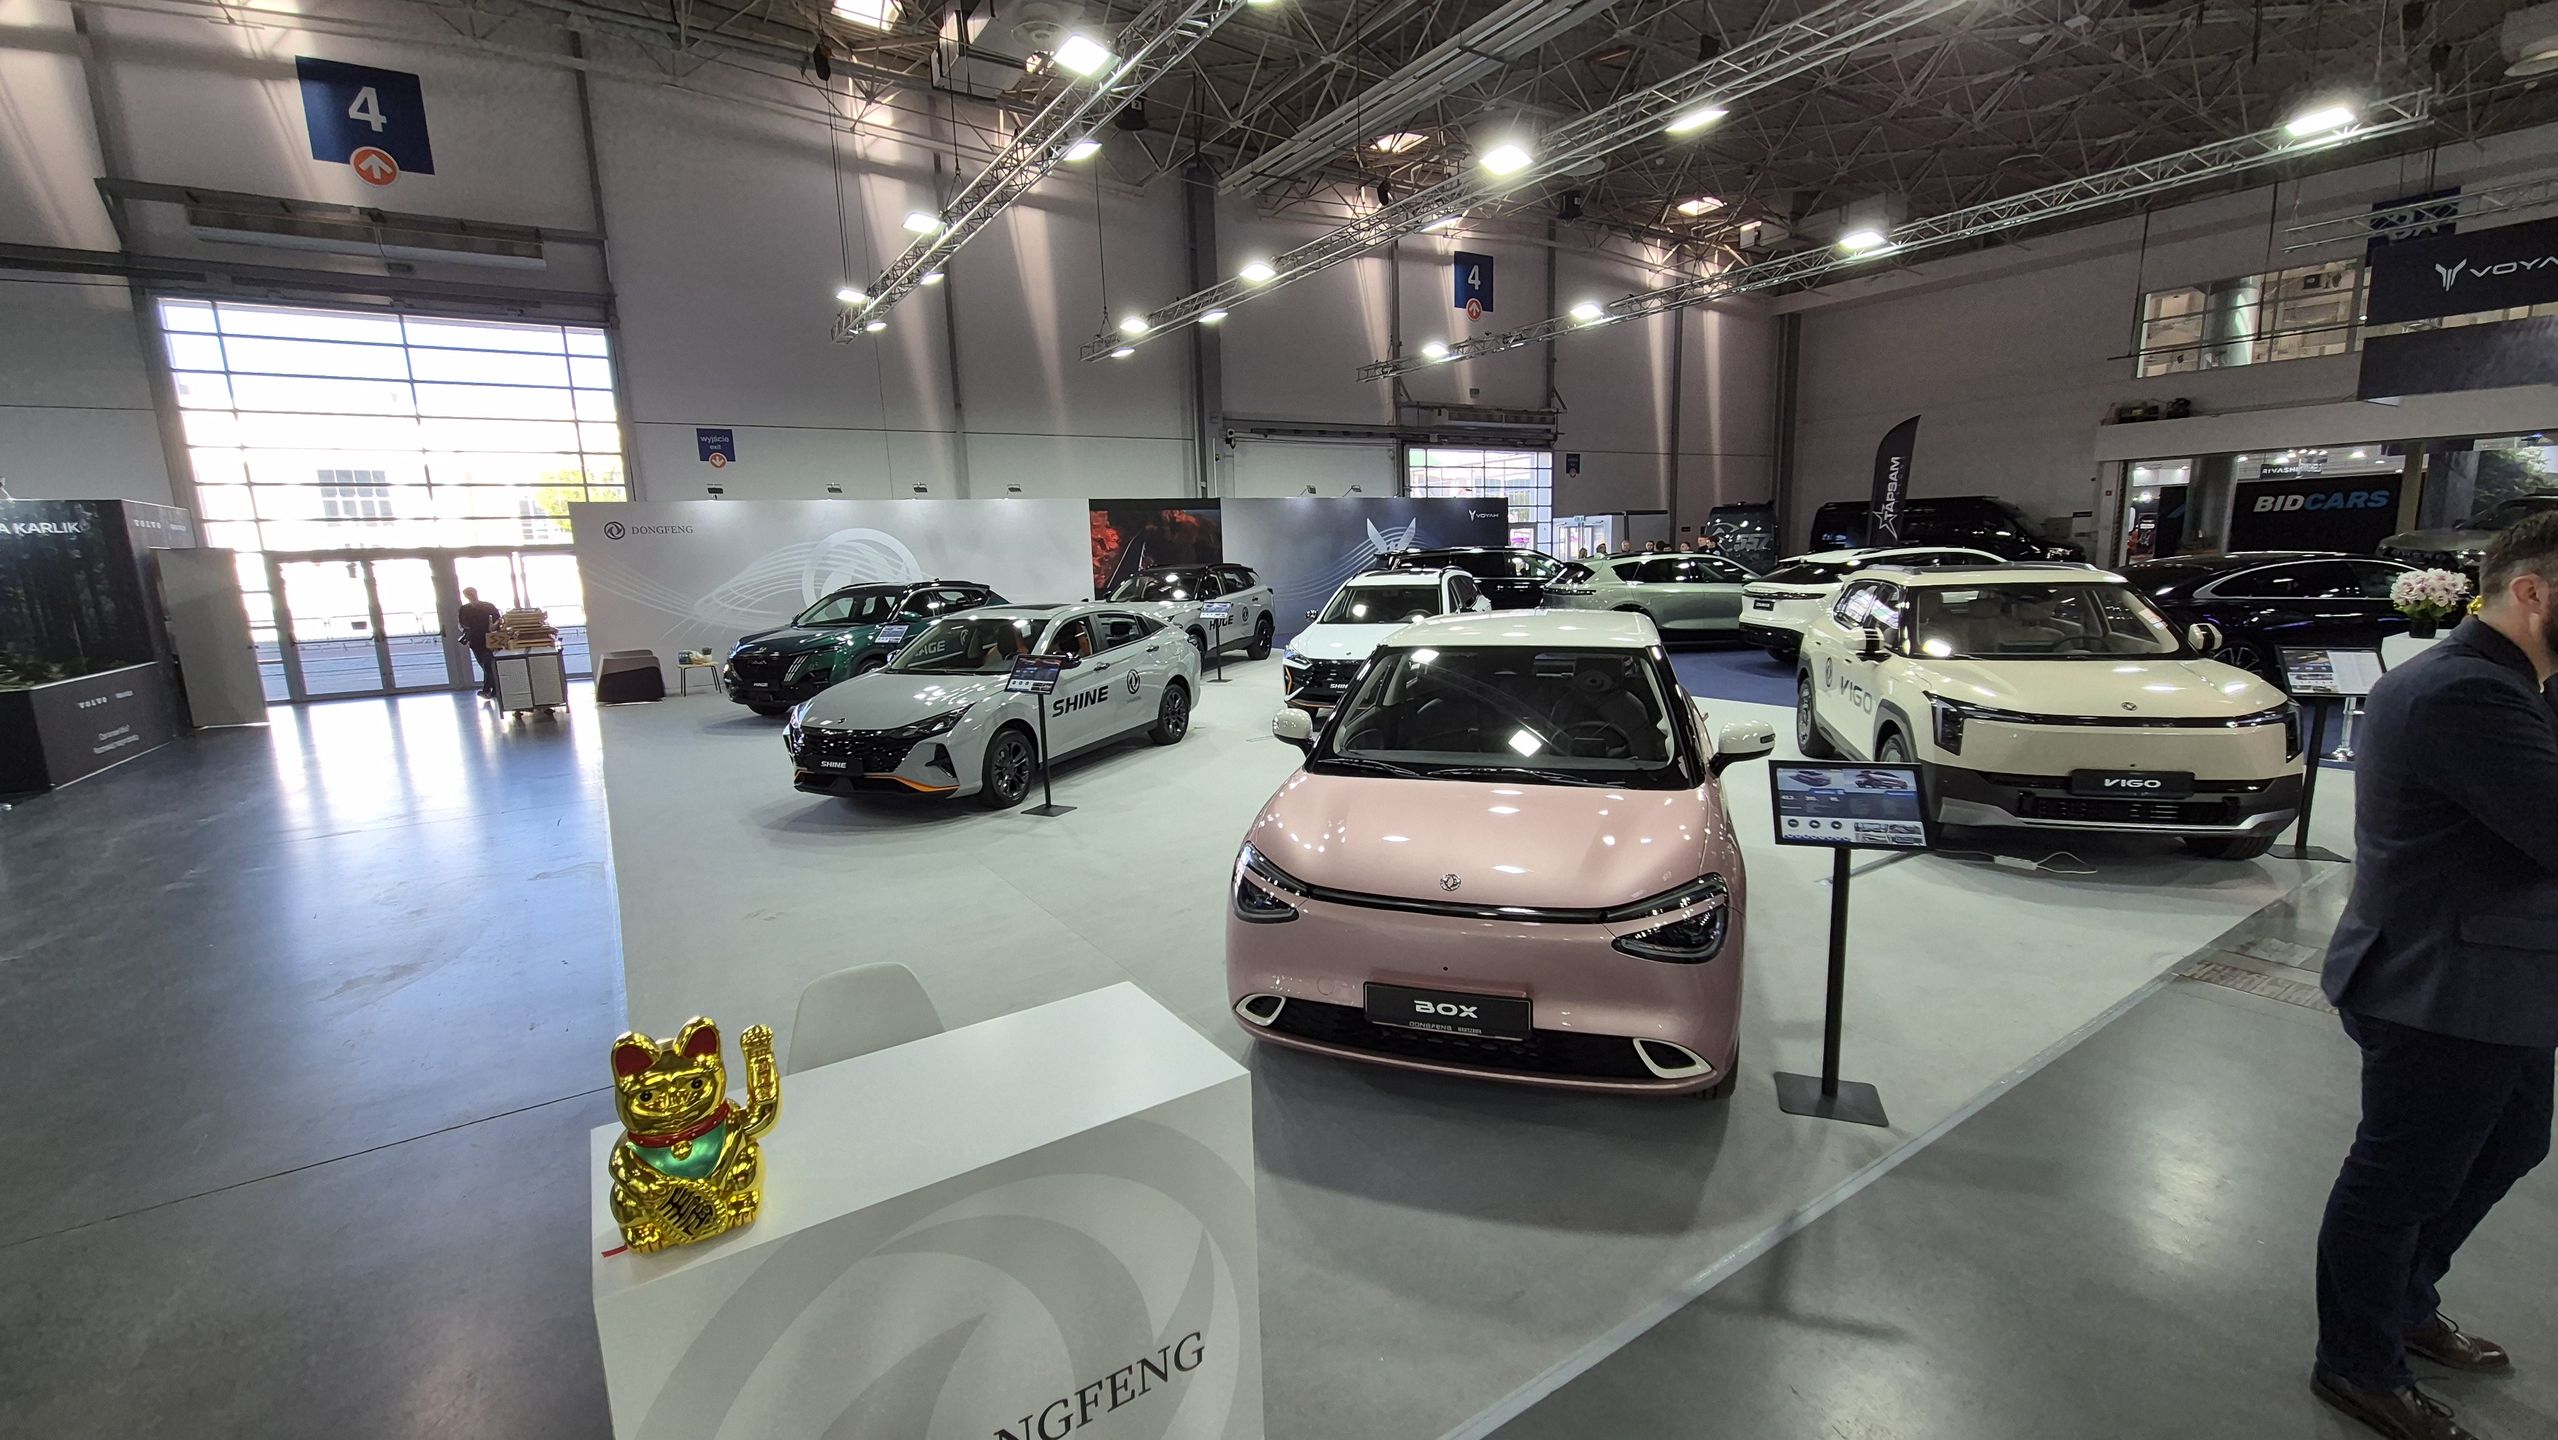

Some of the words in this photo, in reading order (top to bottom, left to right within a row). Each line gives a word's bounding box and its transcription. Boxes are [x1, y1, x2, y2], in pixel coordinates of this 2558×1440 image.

[348, 86, 387, 133] 4
[1468, 265, 1481, 290] 4
[700, 434, 729, 444] wyjście
[1884, 456, 1901, 520] TAPSAM
[2253, 490, 2390, 512] BIDCARS
[14, 522, 82, 535] KARLIK
[631, 525, 694, 535] DONGFENG
[915, 640, 946, 657] AGE
[1052, 685, 1109, 718] SHINE
[1840, 675, 1873, 716] VIGO
[820, 761, 847, 769] SHINE
[2104, 778, 2162, 788] VIGO
[1414, 1000, 1479, 1019] BOX
[1409, 1020, 1453, 1031] DONGFENG
